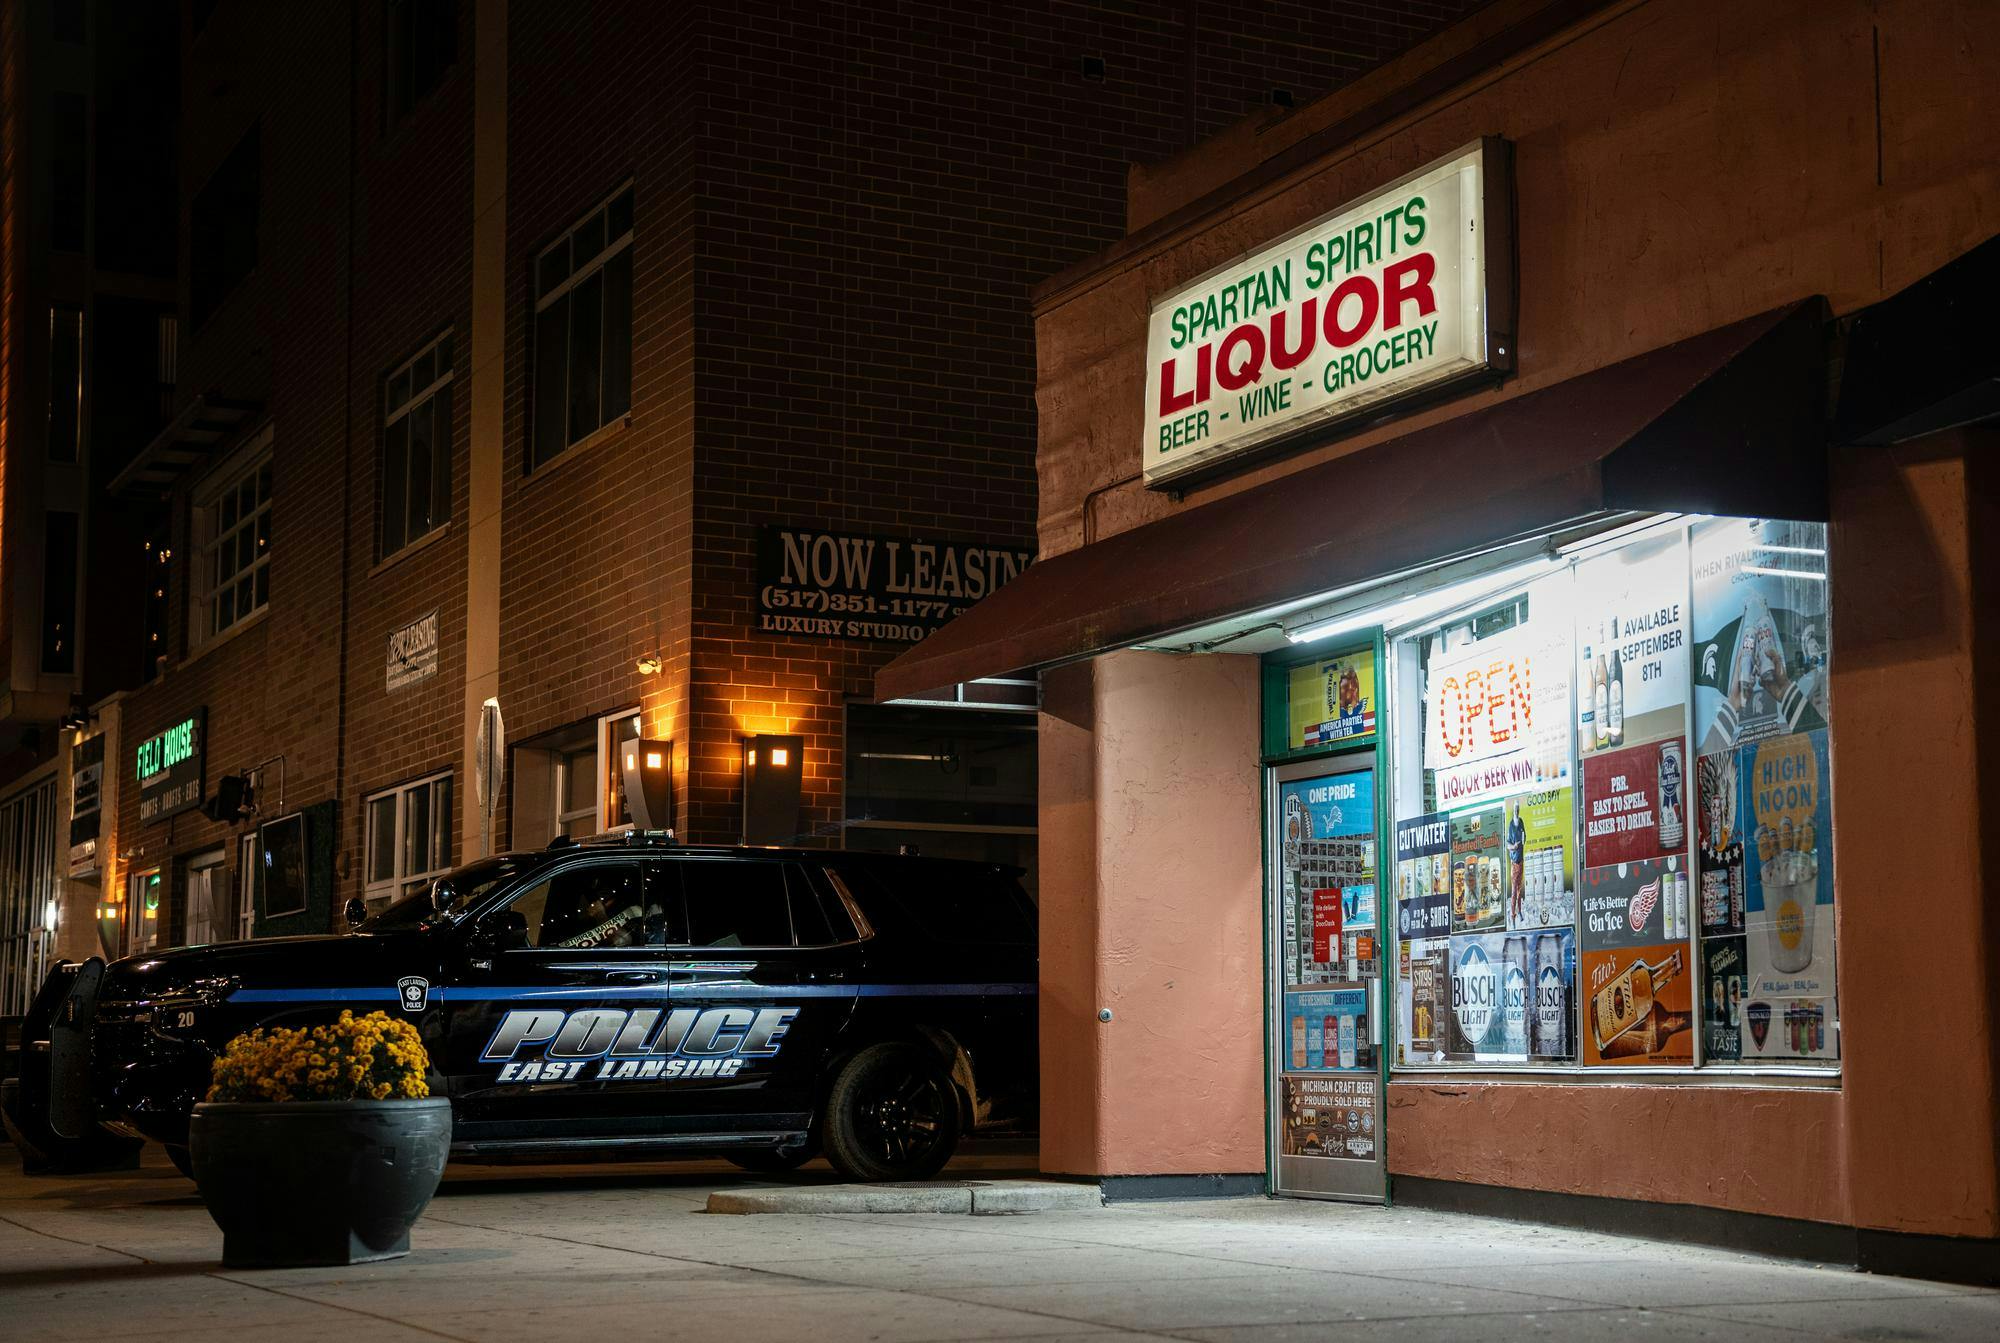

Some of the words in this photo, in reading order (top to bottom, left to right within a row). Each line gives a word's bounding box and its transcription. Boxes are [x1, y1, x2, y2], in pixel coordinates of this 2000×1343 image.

[1170, 259, 1291, 349] SPARTAN
[1306, 196, 1426, 290] SPIRITS
[1159, 252, 1437, 418] LIQUOR
[1159, 409, 1209, 453] BEER
[1239, 378, 1292, 423] WINE
[1324, 321, 1439, 393] GROCERY
[780, 532, 876, 590] NOW
[886, 541, 1038, 600] LEASIN
[1694, 559, 1721, 580] WHEN
[761, 585, 950, 619] (517)351-1177
[762, 614, 842, 635] LUXURY
[847, 619, 924, 641] STUDIO
[1624, 604, 1679, 638] AVAILABLE
[1622, 629, 1682, 663] SEPTEMBER
[1642, 659, 1662, 681] 8TH
[1440, 657, 1532, 757] OPEN
[1319, 719, 1341, 733] AMERICA
[1342, 714, 1363, 728] PARTIES
[1330, 729, 1343, 740] WITH
[1343, 726, 1353, 736] TEA
[136, 736, 160, 781] FIELD
[163, 718, 193, 768] HOUSE
[1443, 773, 1480, 800] LIQUOR
[1484, 767, 1508, 789] BEER
[1510, 760, 1533, 782] WIN
[1763, 754, 1806, 785] HIGH
[1309, 787, 1327, 803] ONE
[1328, 783, 1355, 801] PRIDE
[1611, 775, 1628, 793] PBR.
[1527, 791, 1546, 806] GOOD
[1548, 789, 1560, 803] BOY
[1593, 797, 1612, 816] EASY
[1612, 796, 1623, 812] TO
[1623, 791, 1648, 810] SPELL.
[1760, 784, 1812, 814] NOON
[1588, 817, 1615, 837] EASIER
[1616, 815, 1626, 831] TO
[1627, 810, 1654, 830] DRINK.
[1400, 823, 1446, 850] CUTWATER
[1583, 898, 1598, 911] Life
[1606, 896, 1628, 909] Better
[1421, 908, 1429, 928] 2+
[1430, 905, 1449, 928] SHOTS
[1589, 913, 1604, 932] On
[1604, 912, 1623, 930] Ice
[1592, 954, 1616, 990] Tito's
[400, 979, 409, 988] EAST
[1453, 975, 1497, 1008] BUSCH
[1334, 993, 1362, 1005] DIFFERENT
[1503, 987, 1529, 1008] BUSCH
[1537, 986, 1564, 1008] BUSCH
[1623, 976, 1634, 1017] Tito's
[177, 1010, 195, 1028] 20
[1462, 1010, 1487, 1025] LIGHT
[1508, 1010, 1524, 1021] LIGHT
[1541, 1010, 1559, 1021] LIGHT
[481, 1007, 800, 1061] POLICE
[1324, 1028, 1337, 1039] LONG
[1712, 1037, 1738, 1052] TASTE
[498, 1060, 586, 1080] EAST
[595, 1059, 744, 1080] LANSING
[1302, 1080, 1333, 1093] MICHIGAN
[1334, 1081, 1356, 1094] CRAFT
[1356, 1082, 1374, 1094] BEER
[1304, 1095, 1333, 1106] PROUDLY
[1334, 1096, 1353, 1107] SOLD
[1353, 1097, 1371, 1107] HERE
